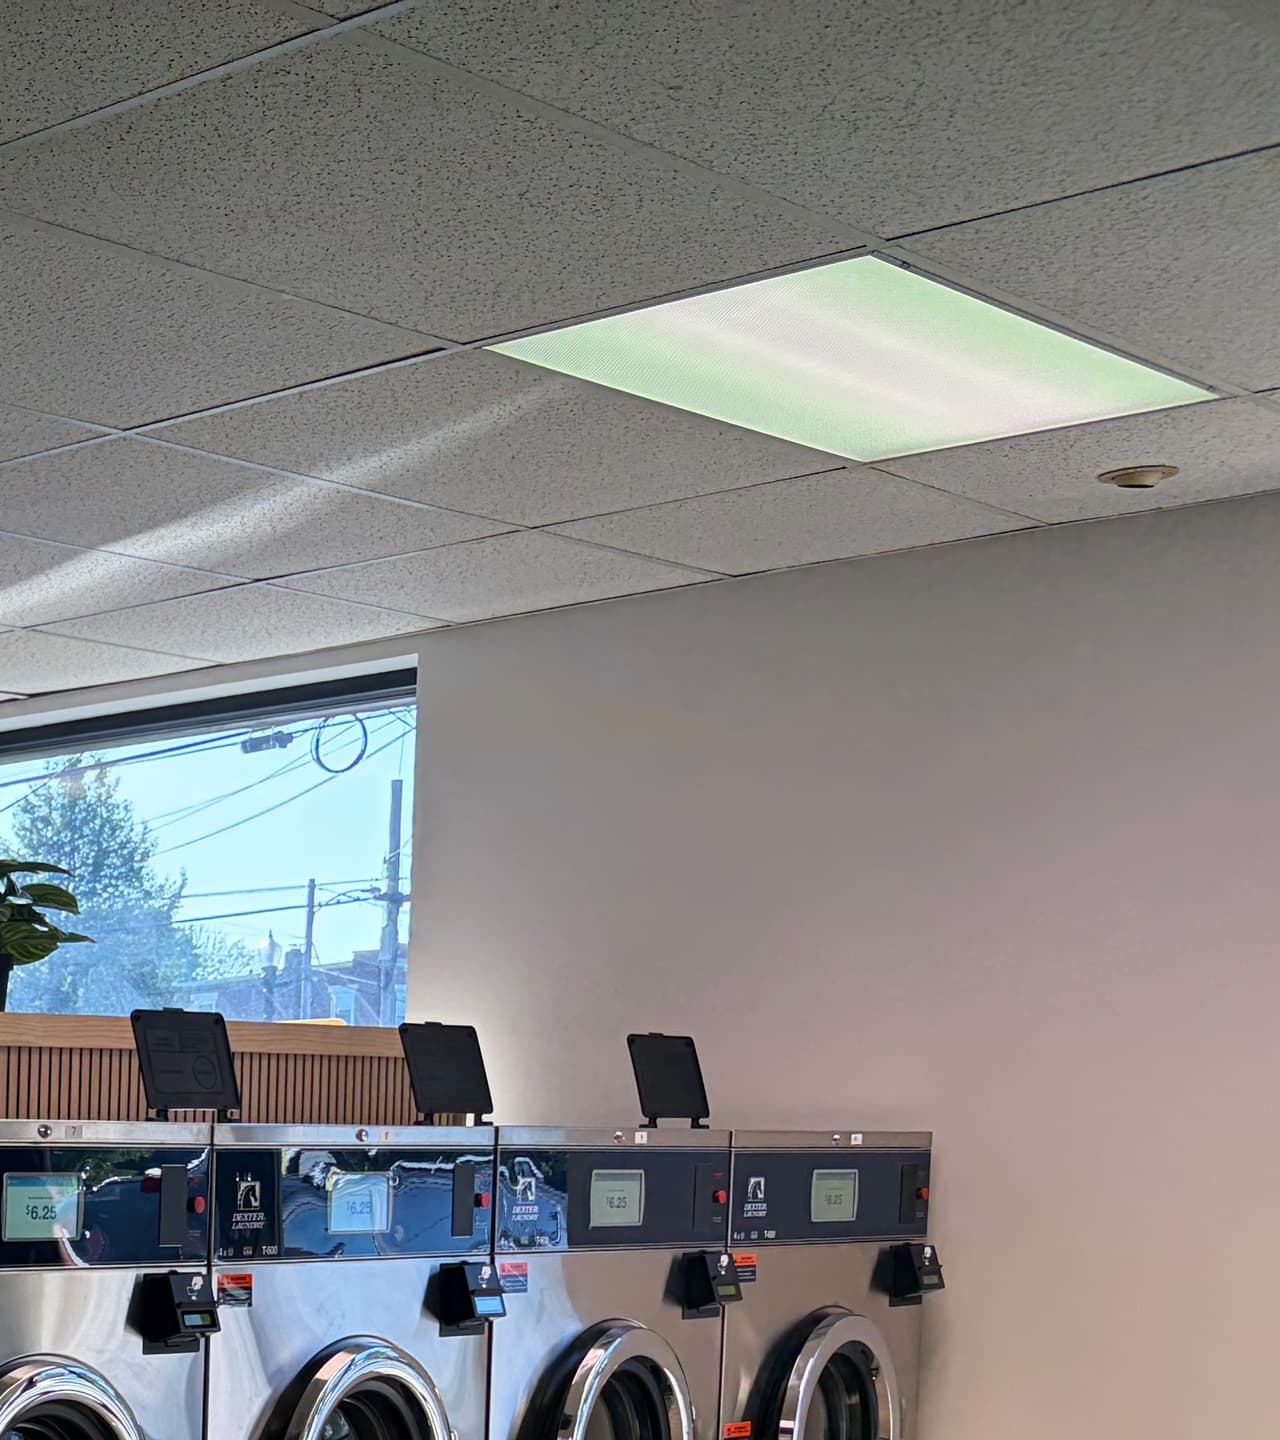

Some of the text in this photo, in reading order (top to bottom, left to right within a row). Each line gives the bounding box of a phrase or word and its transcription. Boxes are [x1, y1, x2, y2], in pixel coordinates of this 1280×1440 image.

[72, 1126, 78, 1137] 7
[26, 1204, 57, 1220] $6.25
[232, 1212, 264, 1222] DEXTER
